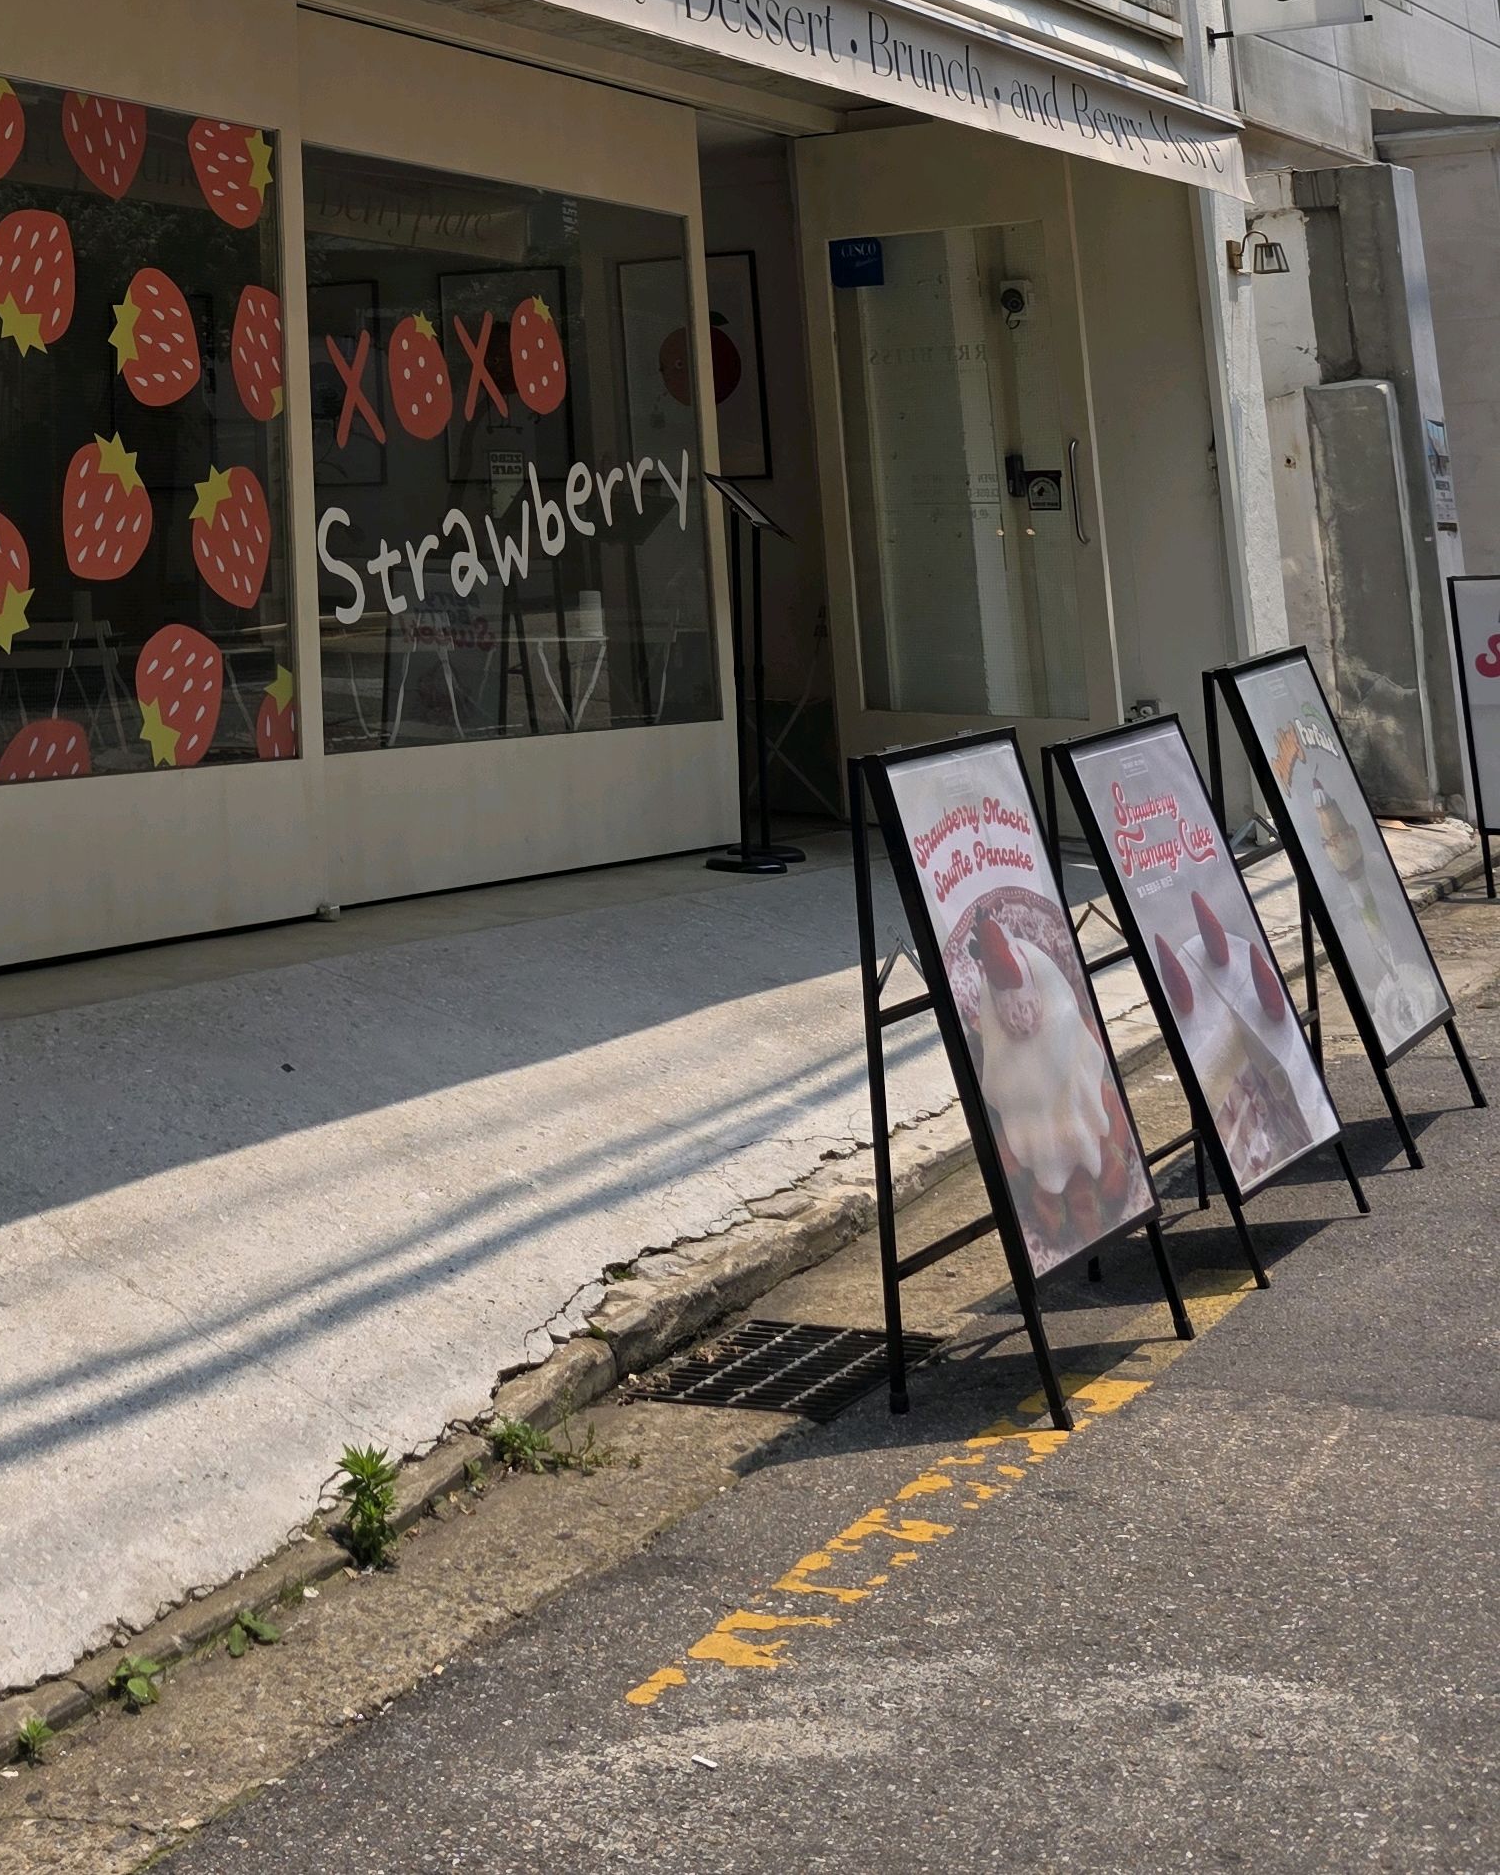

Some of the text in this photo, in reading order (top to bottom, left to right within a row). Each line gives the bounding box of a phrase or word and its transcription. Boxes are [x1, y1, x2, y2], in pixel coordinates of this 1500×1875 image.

[868, 11, 989, 109] Brunch
[1010, 74, 1065, 131] and
[1072, 82, 1151, 166] Berry
[1148, 109, 1225, 174] More
[317, 449, 689, 625] Strawberry
[913, 796, 1031, 870] Strawberry Mochi
[1111, 781, 1179, 829] Strawberry
[973, 840, 1034, 872] Pancake
[1114, 817, 1220, 879] Fromage Cake
